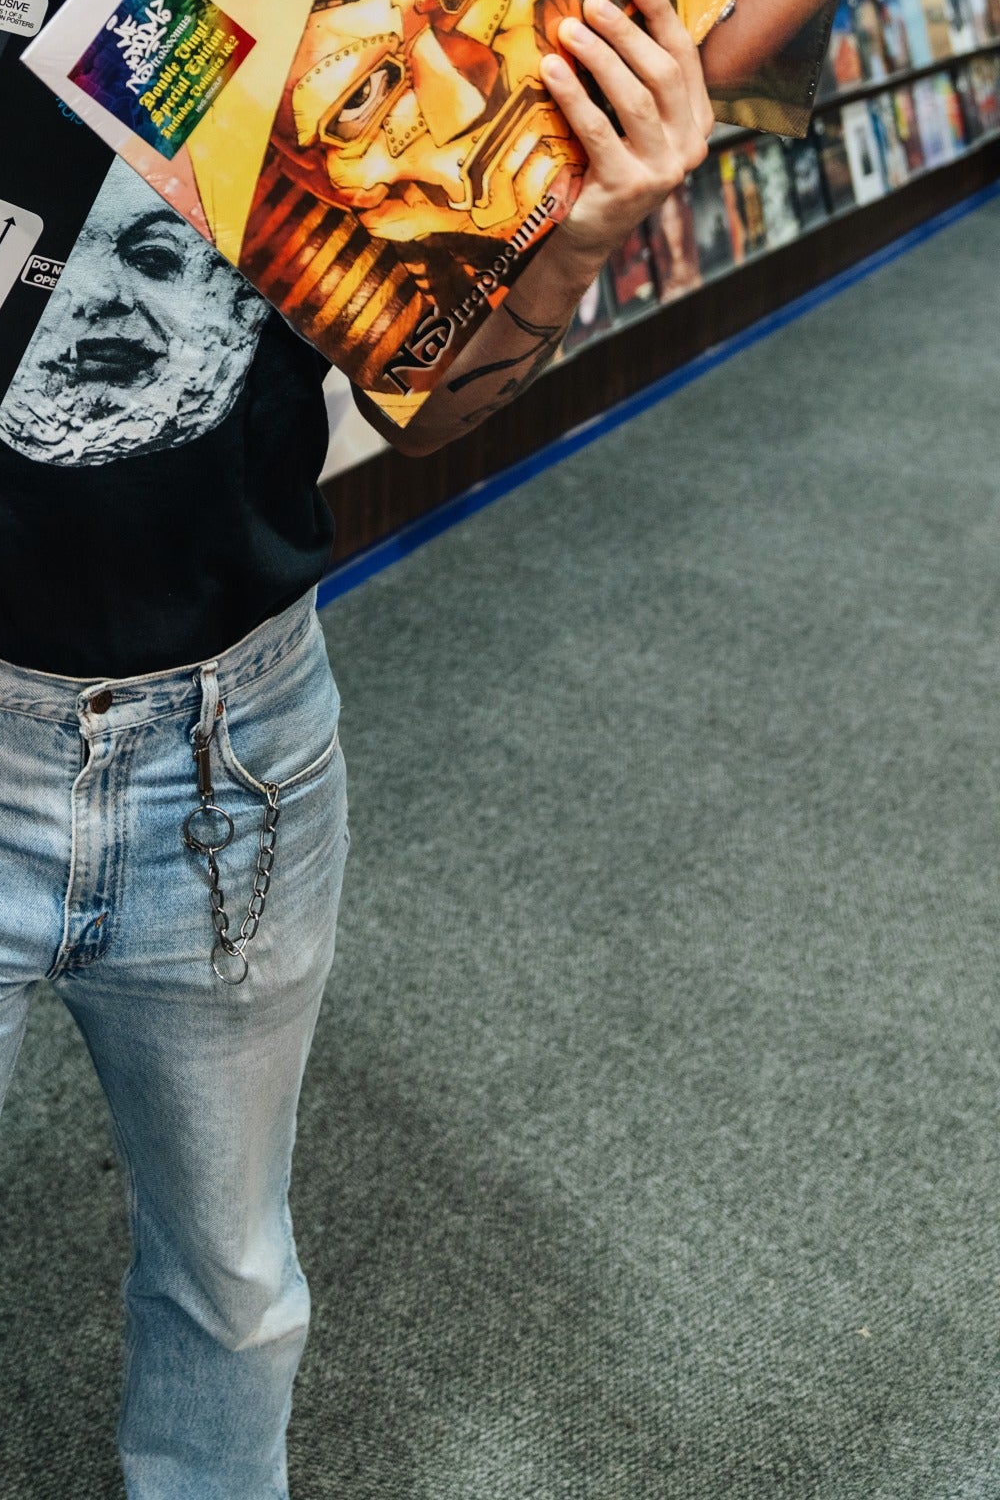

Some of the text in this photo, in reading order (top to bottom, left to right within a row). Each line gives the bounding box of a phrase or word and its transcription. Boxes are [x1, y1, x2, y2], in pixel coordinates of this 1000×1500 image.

[6, 16, 35, 29] POSTERS
[138, 18, 210, 111] Double Vinyl
[150, 28, 226, 128] Special Edition
[160, 97, 196, 140] Includes
[189, 57, 226, 97] Volumes
[31, 259, 51, 272] DO
[33, 273, 59, 287] OPE
